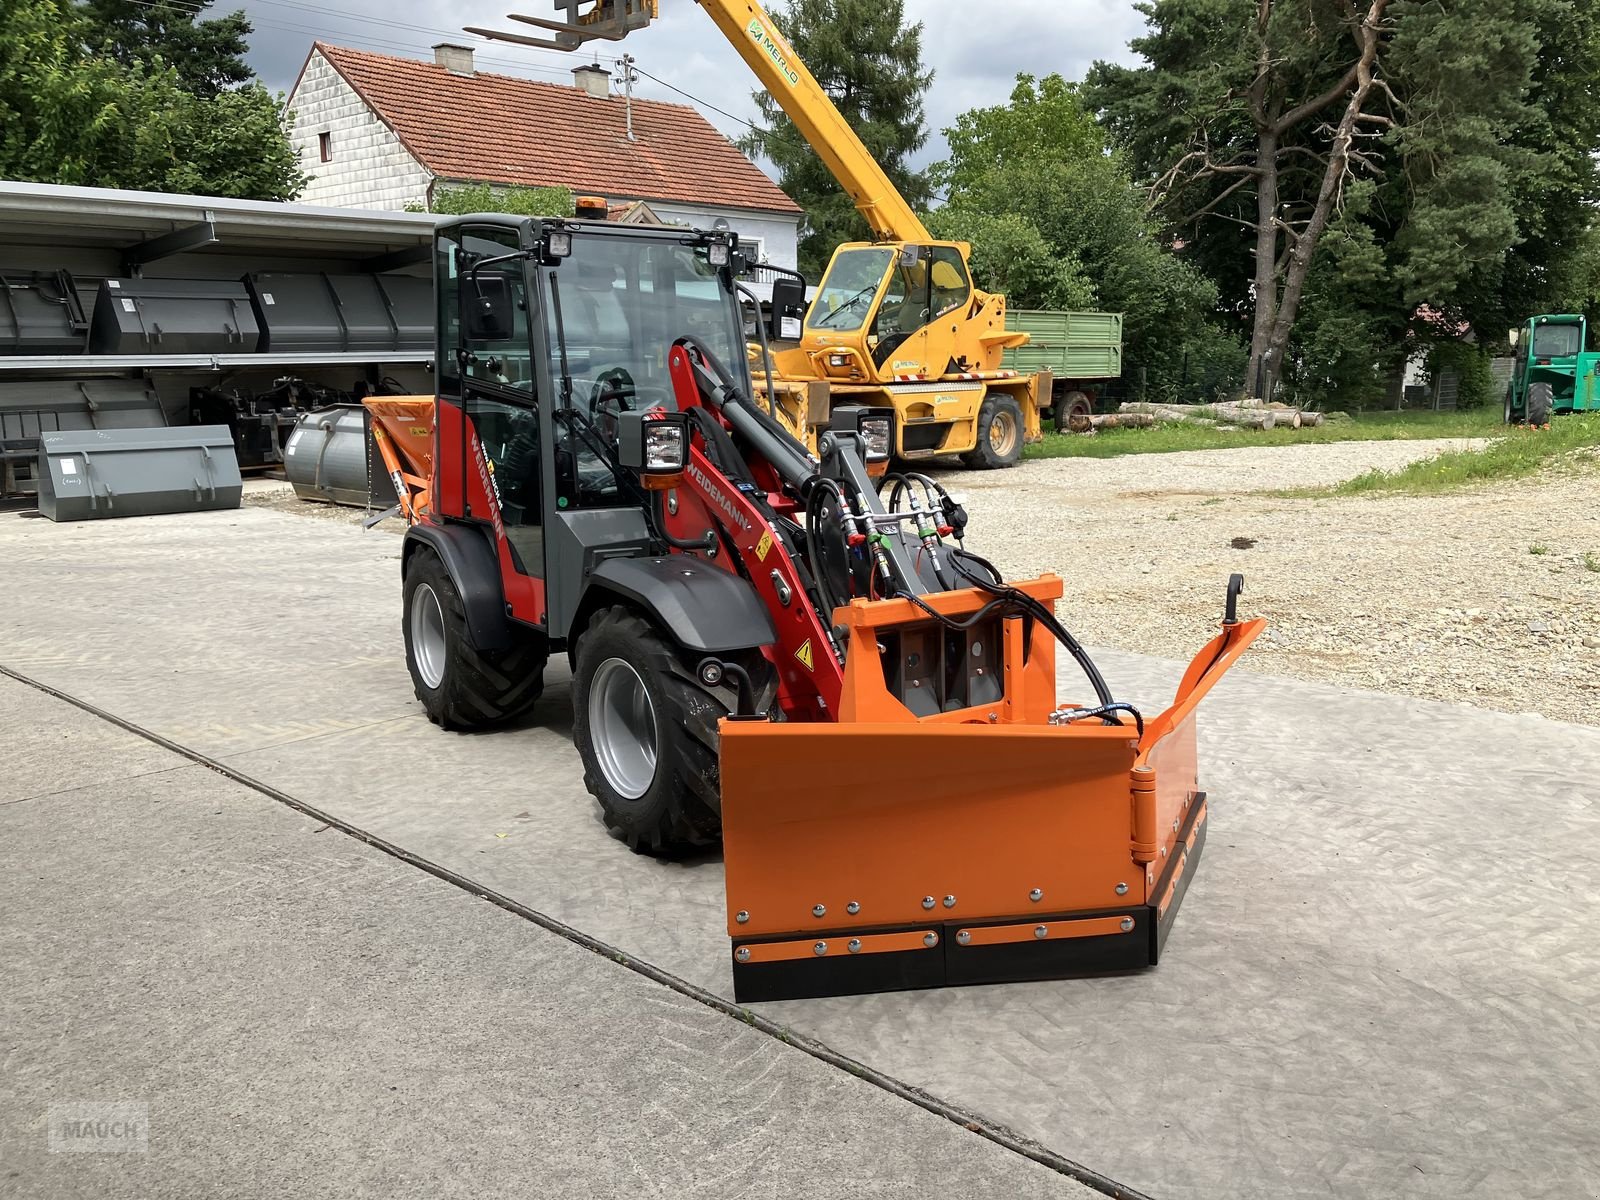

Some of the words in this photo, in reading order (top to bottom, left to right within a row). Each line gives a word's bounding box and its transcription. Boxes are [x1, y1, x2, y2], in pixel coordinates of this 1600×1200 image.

[763, 37, 799, 84] MERLO
[471, 432, 504, 541] WEIDEMANN
[687, 462, 749, 531] WEIDEMANN
